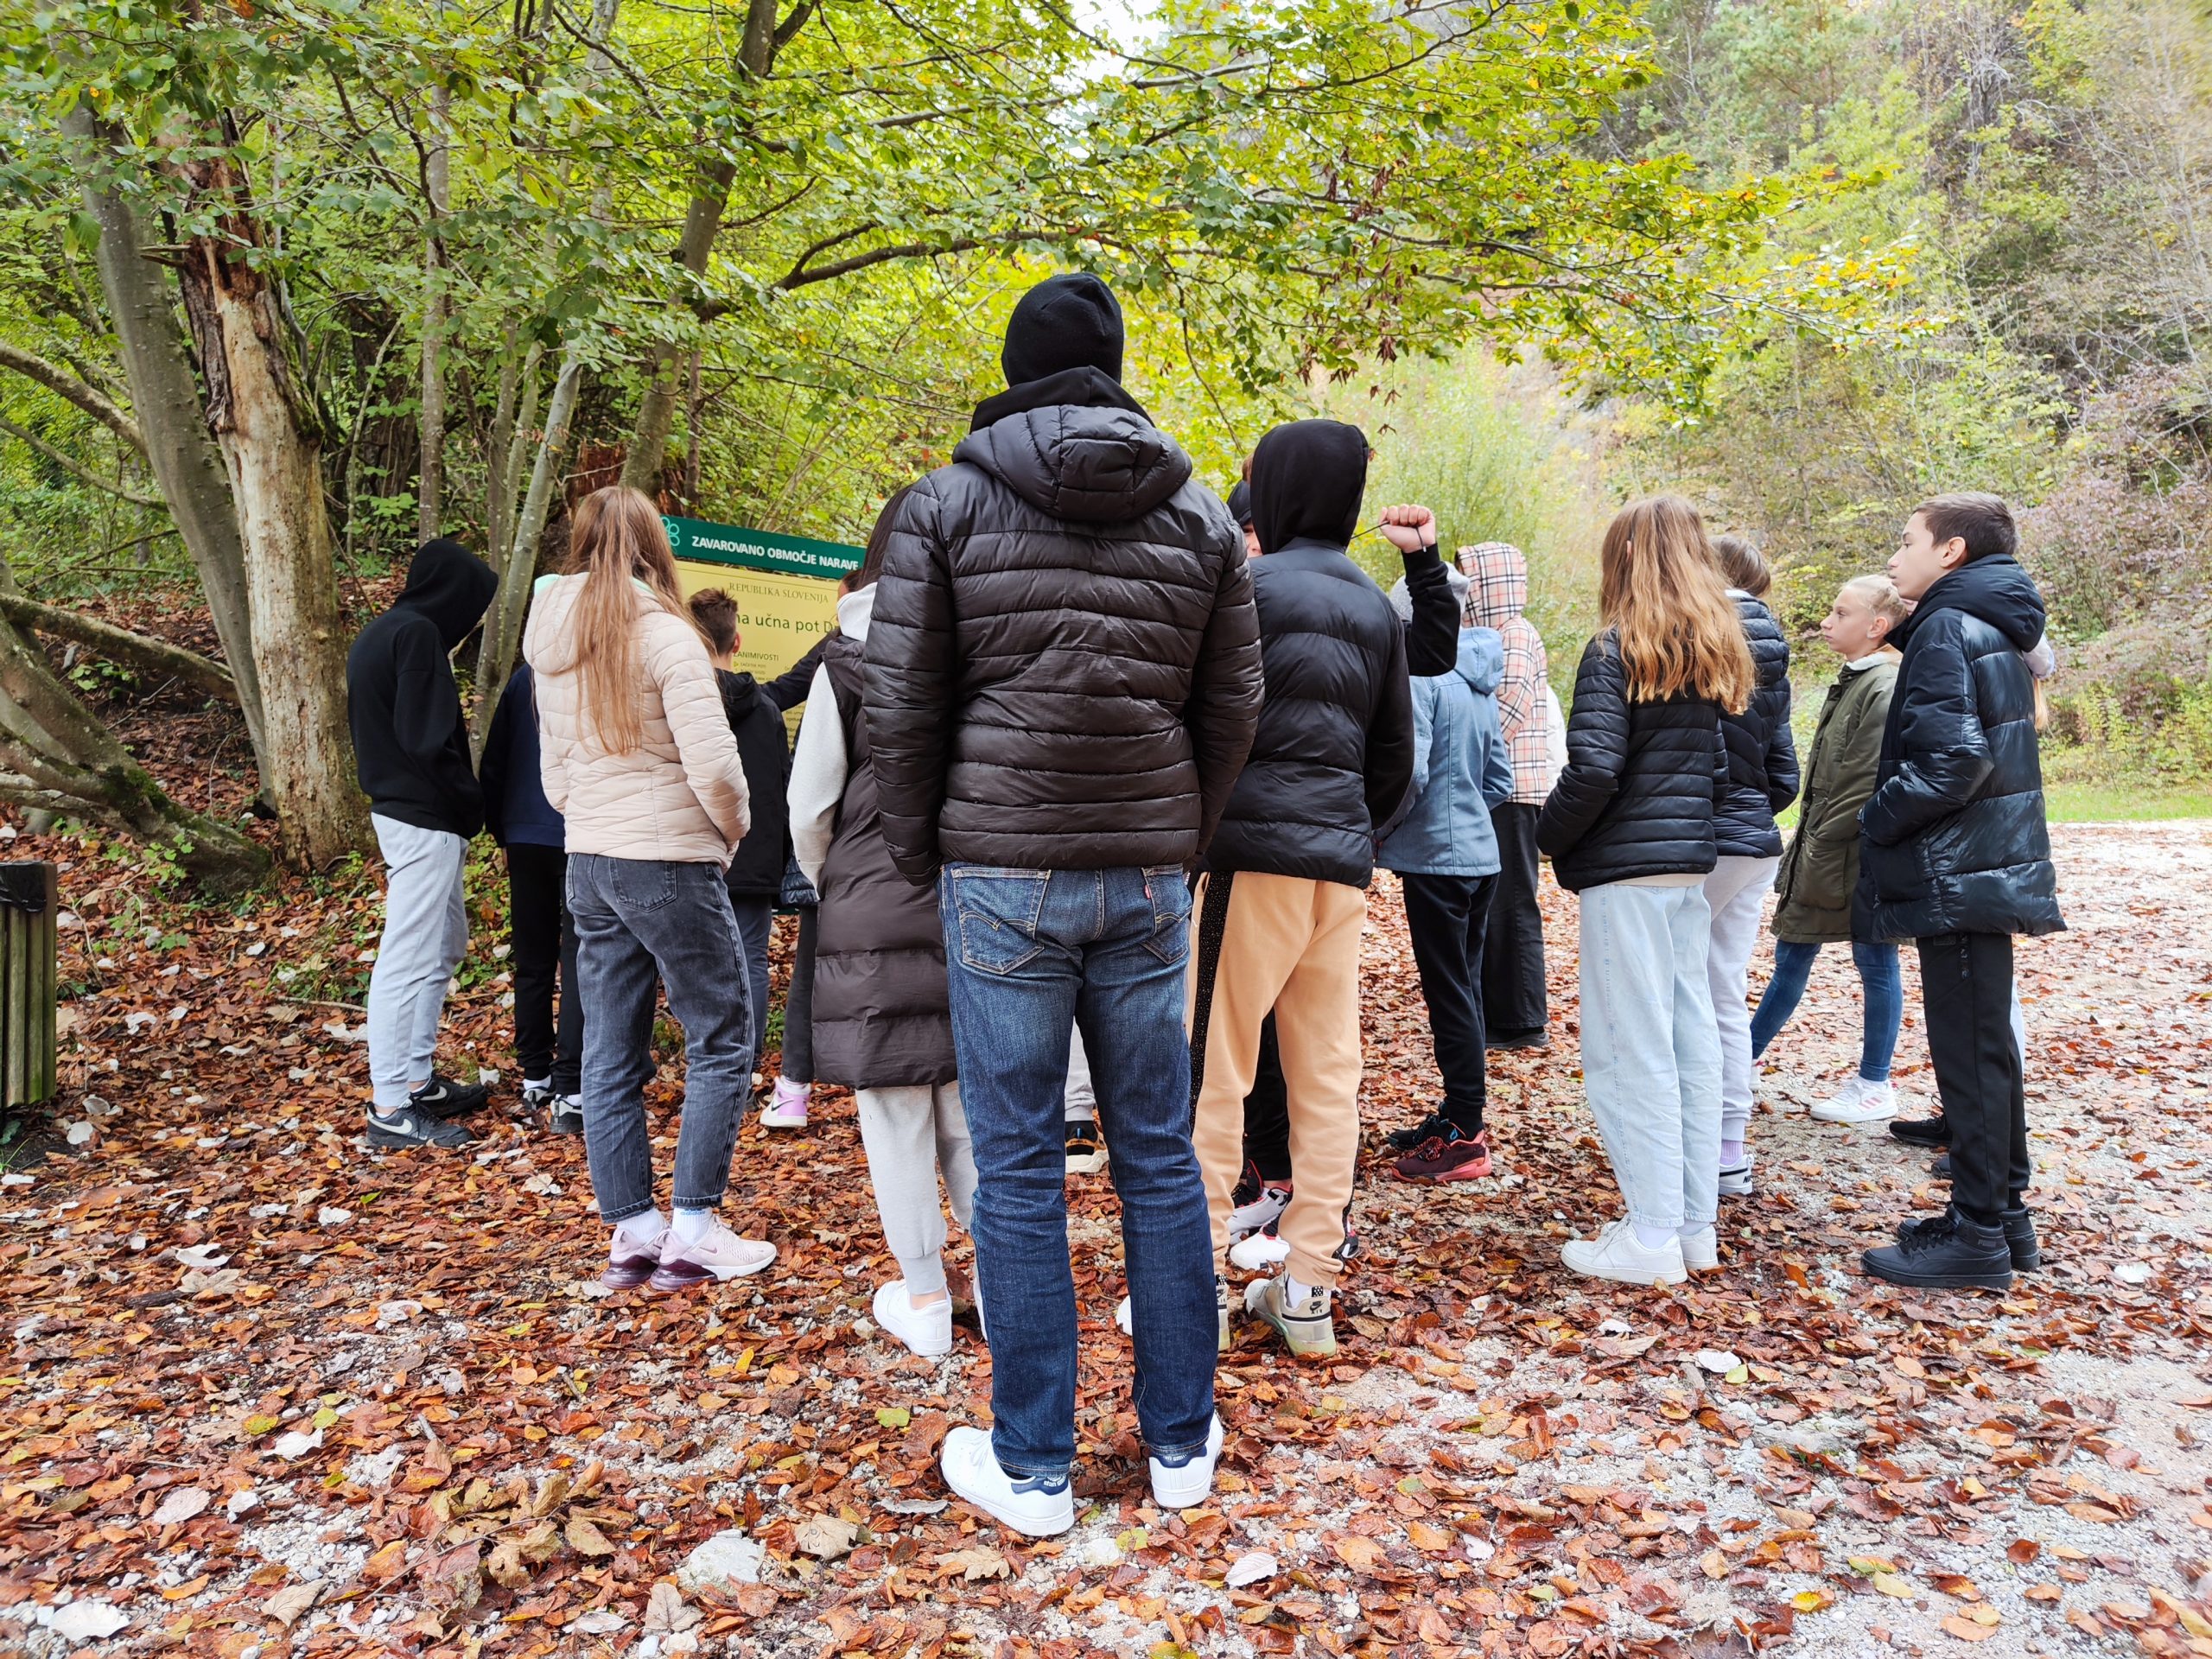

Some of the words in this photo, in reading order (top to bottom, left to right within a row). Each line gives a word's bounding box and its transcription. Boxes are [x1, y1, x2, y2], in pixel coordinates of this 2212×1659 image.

[691, 536, 765, 556] ZAVAROVANO
[767, 548, 817, 564] OBMOČJE
[819, 556, 858, 570] NARAVE
[729, 582, 780, 597] REPUBLIKA
[782, 589, 829, 604] SLOVENIJA
[755, 613, 790, 629] učna
[796, 620, 820, 633] pot
